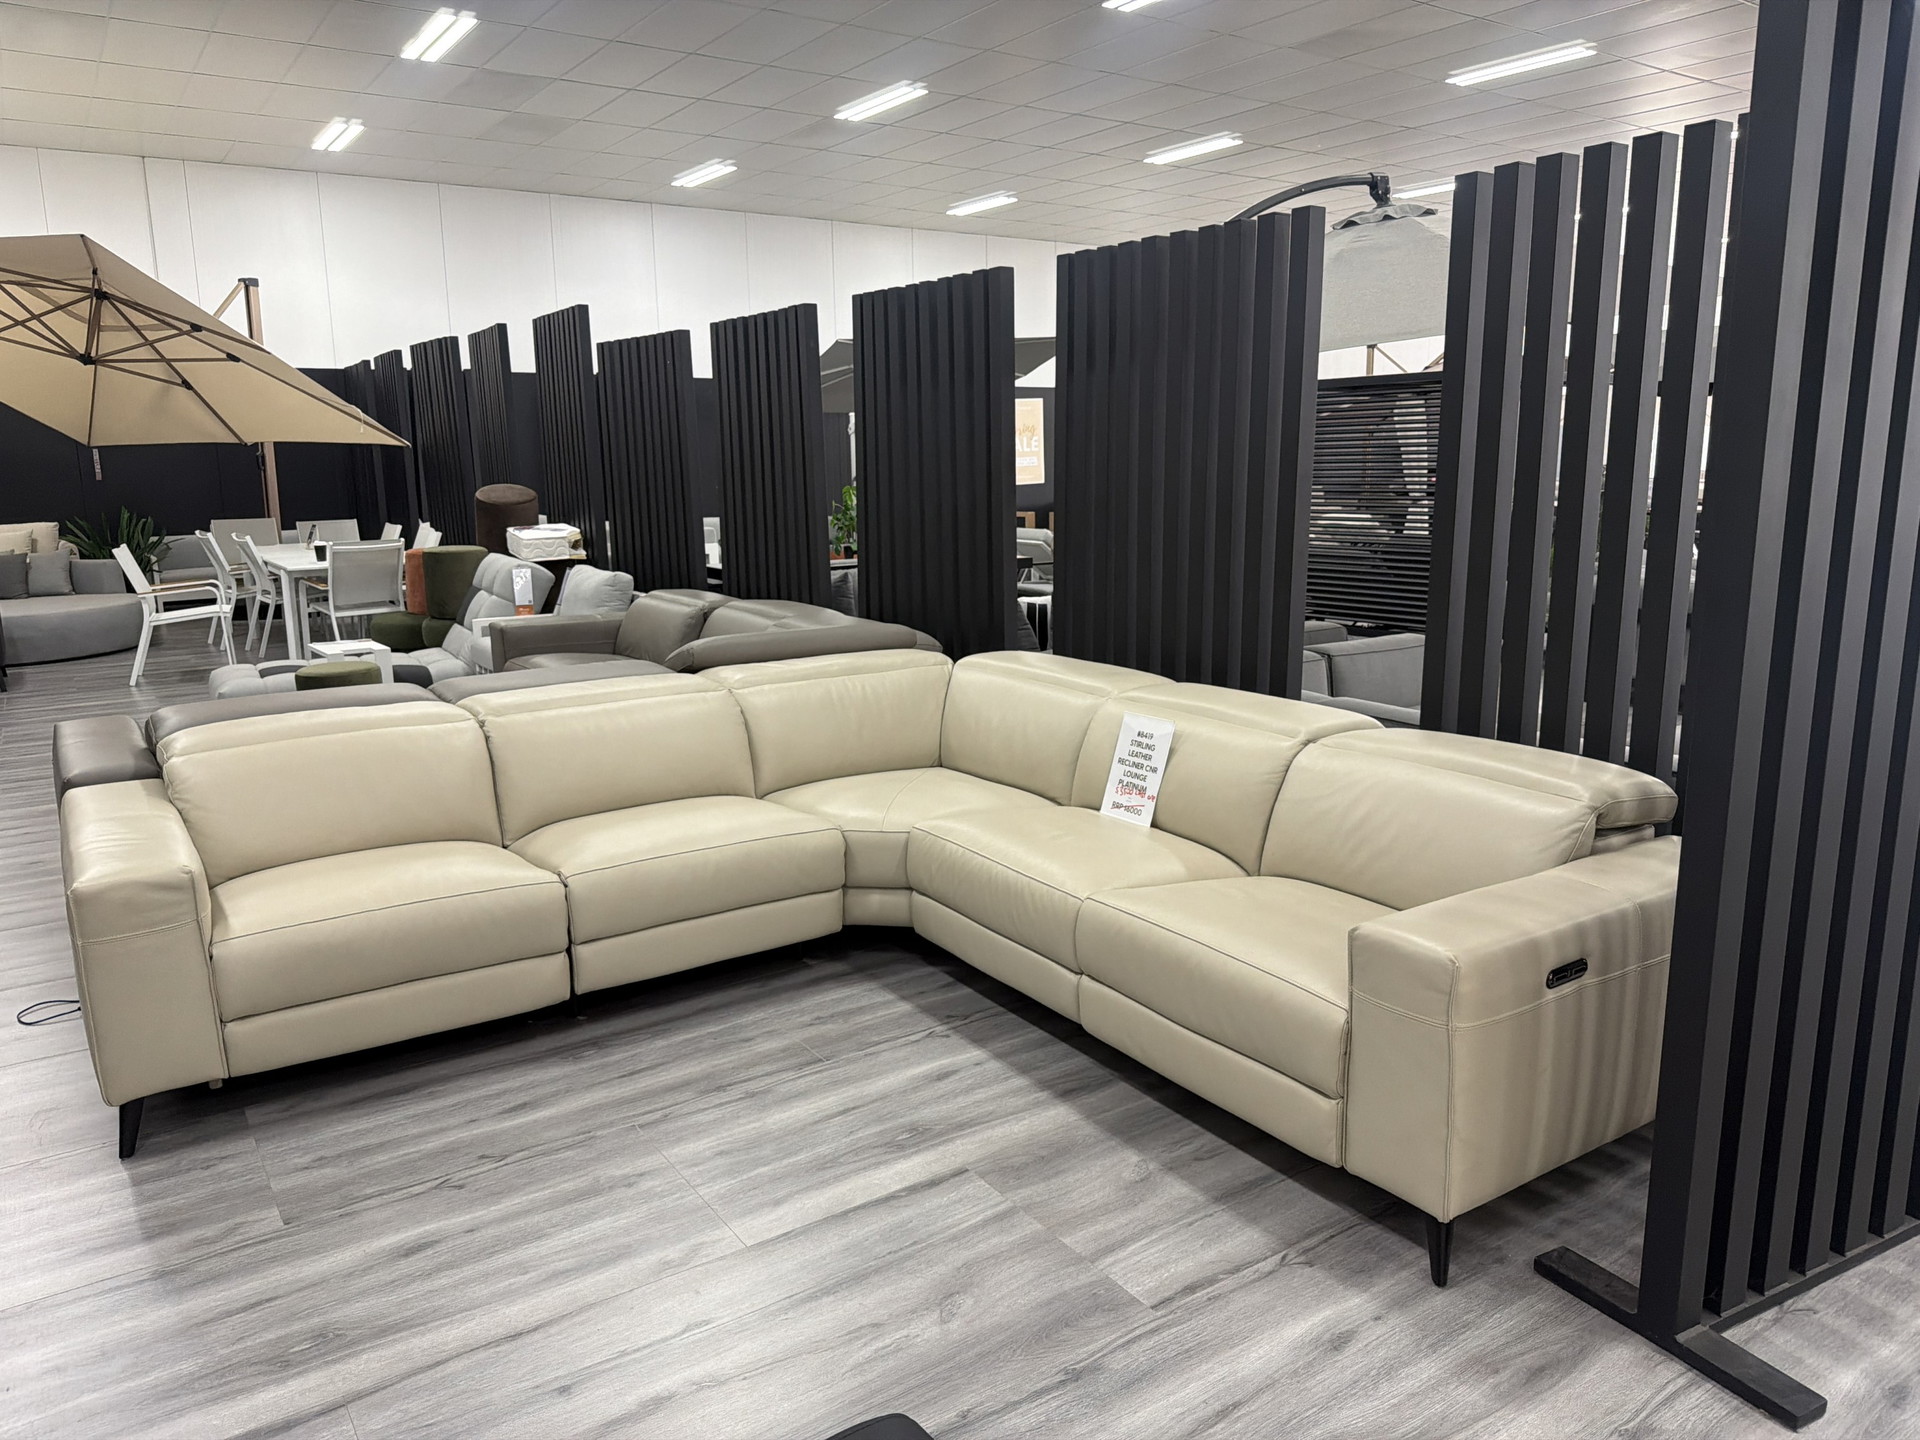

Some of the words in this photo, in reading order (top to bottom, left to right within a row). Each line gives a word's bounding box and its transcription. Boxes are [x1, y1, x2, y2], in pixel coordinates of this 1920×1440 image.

[1016, 435, 1038, 451] ALE
[1130, 739, 1156, 752] STIRLING
[1128, 749, 1153, 762] LEATHER
[1117, 757, 1145, 771] RECLINER
[1145, 764, 1158, 774] CNR
[1123, 769, 1148, 782] LOUNGE
[1117, 779, 1147, 792] PLATINUM
